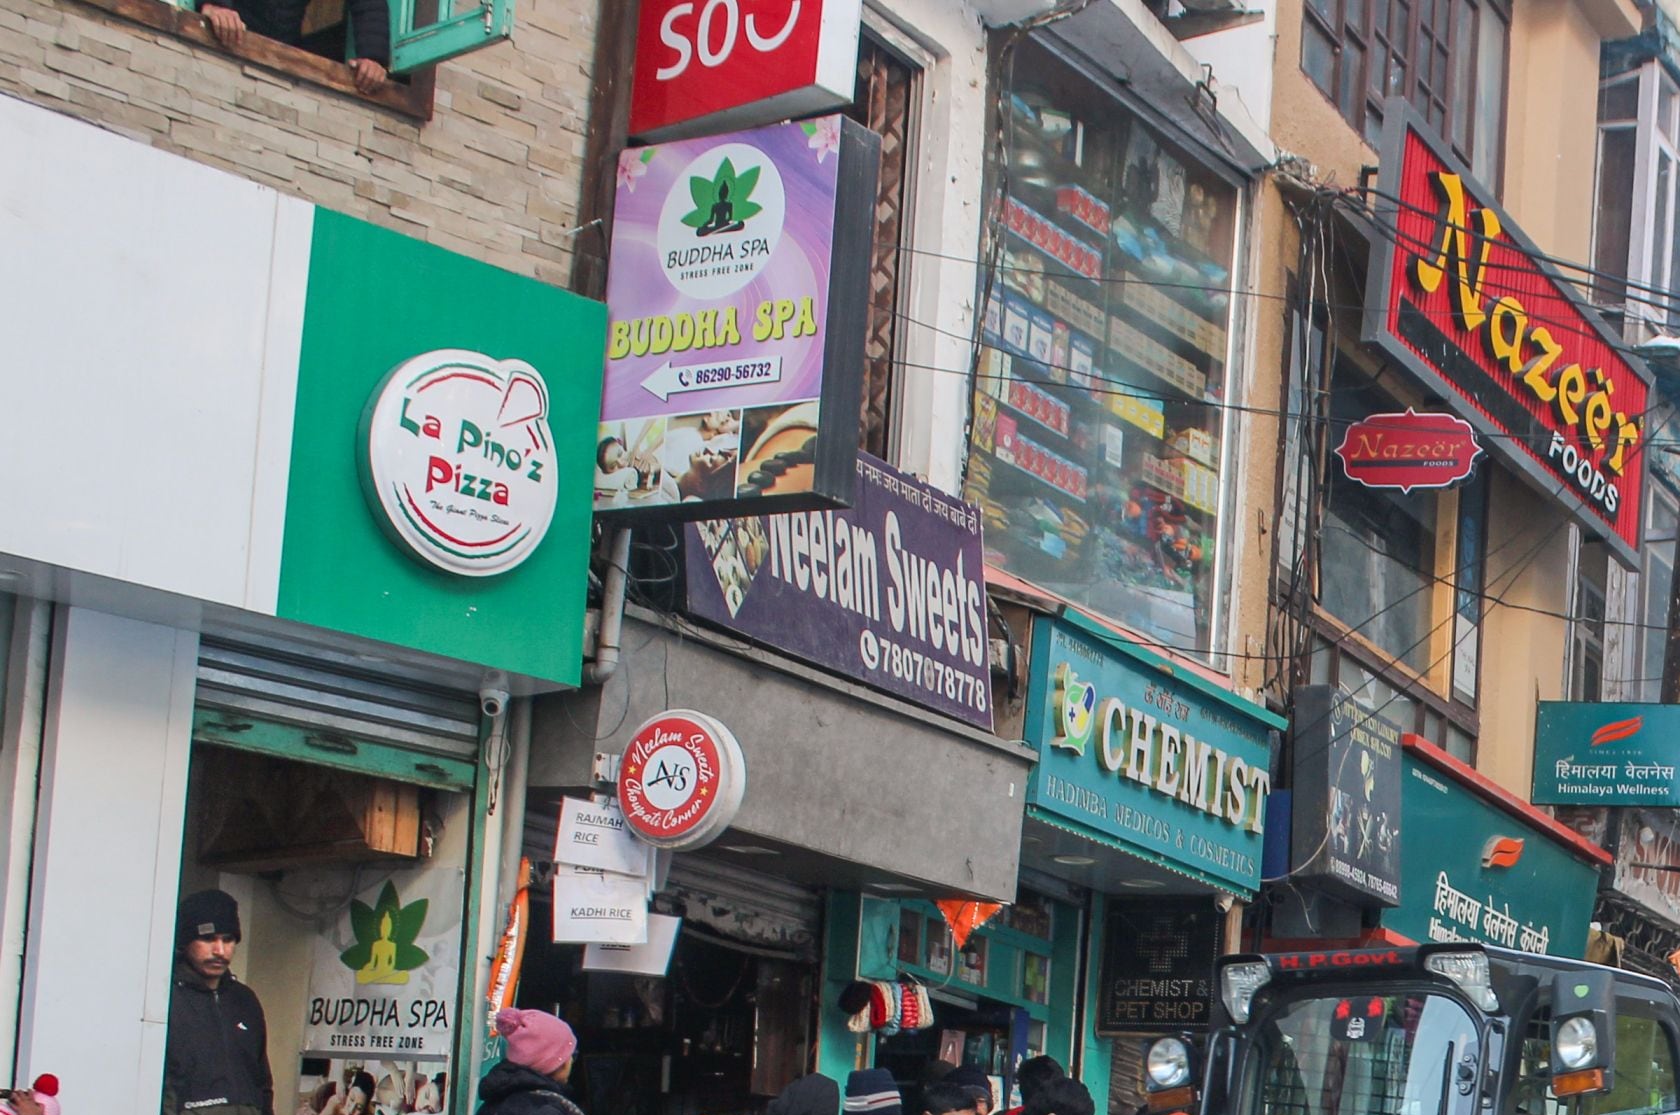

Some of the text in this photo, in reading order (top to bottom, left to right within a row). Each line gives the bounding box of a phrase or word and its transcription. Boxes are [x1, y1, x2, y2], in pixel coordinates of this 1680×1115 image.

[667, 238, 770, 269] BUDDHA SPA
[680, 263, 754, 280] STRESS FREE ZONE
[607, 296, 817, 360] BUDDHA SPA
[695, 362, 771, 384] 86290-56732
[400, 397, 544, 483] La Pino'z
[425, 455, 509, 506] Pizza
[1548, 430, 1620, 514] FOODS
[883, 471, 899, 496] जय
[900, 480, 920, 506] माता
[934, 497, 949, 521] जय
[770, 510, 984, 667] Neelam Sweets
[632, 728, 714, 783] Neelam Sweets
[1097, 697, 1271, 835] CHEMIST
[1555, 760, 1675, 780] हिमालया वेलनेस
[1558, 783, 1669, 796] Himalaya Wellness
[575, 812, 623, 828] RAJMAH
[662, 799, 702, 829] Corner
[1046, 775, 1255, 878] HADIMBA MEDICOS & COSMETICS
[574, 831, 599, 843] RICE
[570, 907, 632, 919] KADHI RICE
[1434, 871, 1549, 955] हिमालया वेलनेस कंपनी
[1115, 979, 1208, 997] CHEMIST &
[310, 998, 448, 1028] BUDDHA SPA
[1115, 1001, 1204, 1020] PET SHOP
[330, 1034, 424, 1049] STRESS FREE ZONE
